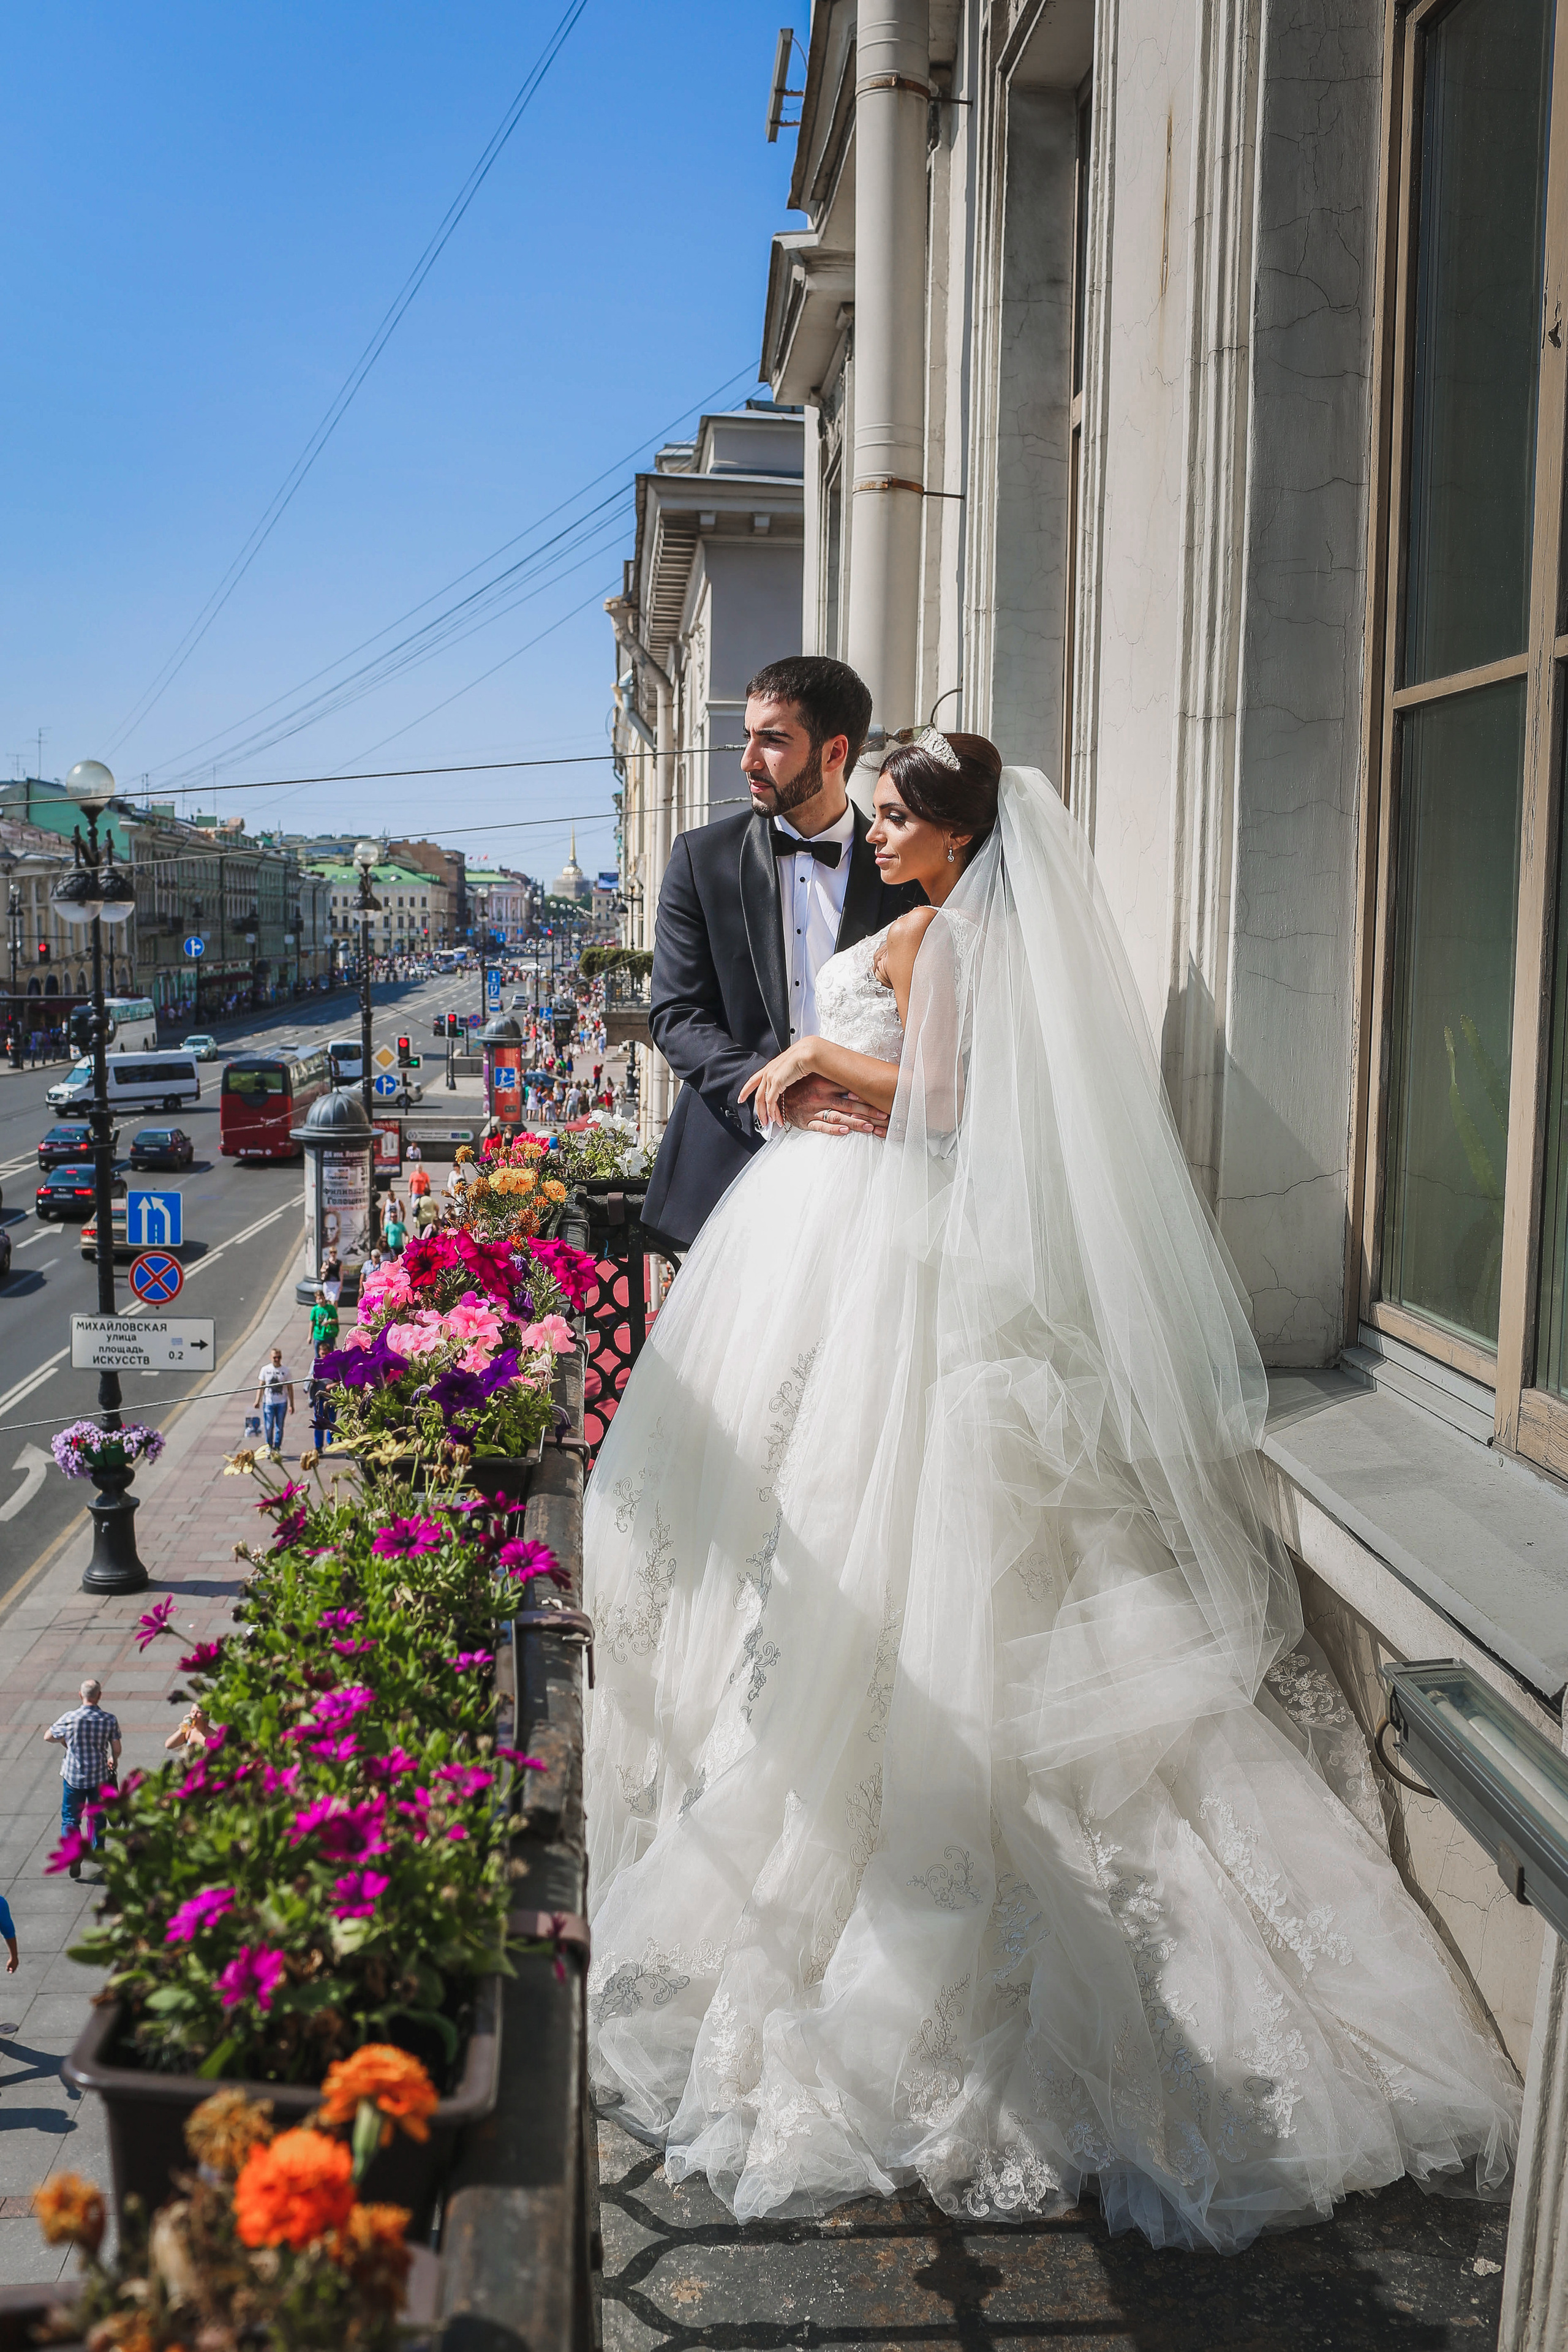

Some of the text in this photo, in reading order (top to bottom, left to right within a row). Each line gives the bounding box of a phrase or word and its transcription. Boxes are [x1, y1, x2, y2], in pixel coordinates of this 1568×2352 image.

[76, 1321, 167, 1332] МИХАЙЛОВСКАЯ
[107, 1333, 137, 1343] улица
[99, 1346, 144, 1354] площадь
[92, 1355, 150, 1365] ИСКУССТВ
